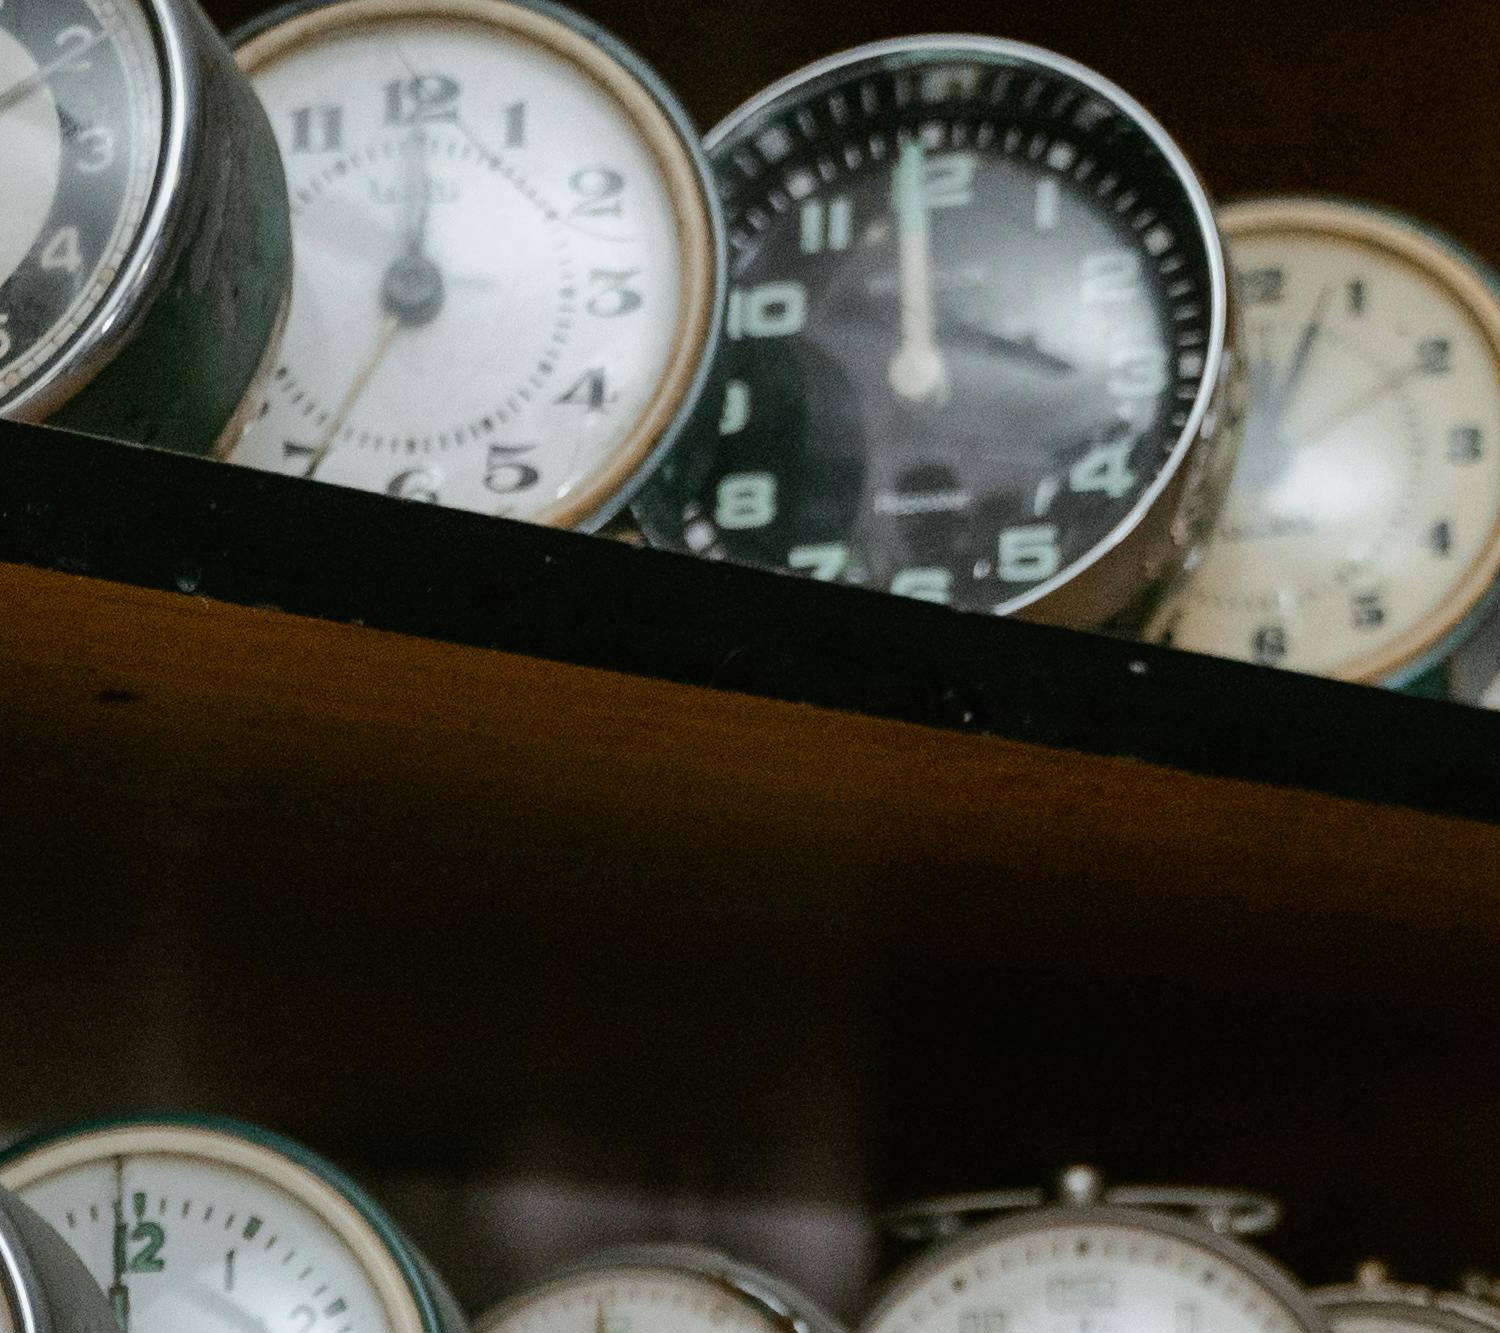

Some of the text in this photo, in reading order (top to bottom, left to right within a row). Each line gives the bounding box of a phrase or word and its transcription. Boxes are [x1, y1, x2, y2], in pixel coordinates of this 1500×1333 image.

[54, 25, 94, 71] 2
[383, 73, 461, 128] 12
[502, 101, 526, 149] 1
[75, 126, 116, 174] 3
[291, 105, 343, 153] 11
[568, 164, 624, 218] 2
[1035, 179, 1059, 230] 1
[40, 226, 82, 274] 4
[800, 197, 853, 254] 11
[586, 267, 643, 319] 3
[726, 282, 807, 341] 10
[554, 368, 618, 414] 4
[483, 444, 539, 496] 5
[1069, 442, 1136, 498] 4
[715, 472, 777, 529] 8
[788, 542, 848, 582] 7
[998, 524, 1061, 583] 5
[128, 1222, 165, 1273] 2
[223, 1247, 237, 1291] 1
